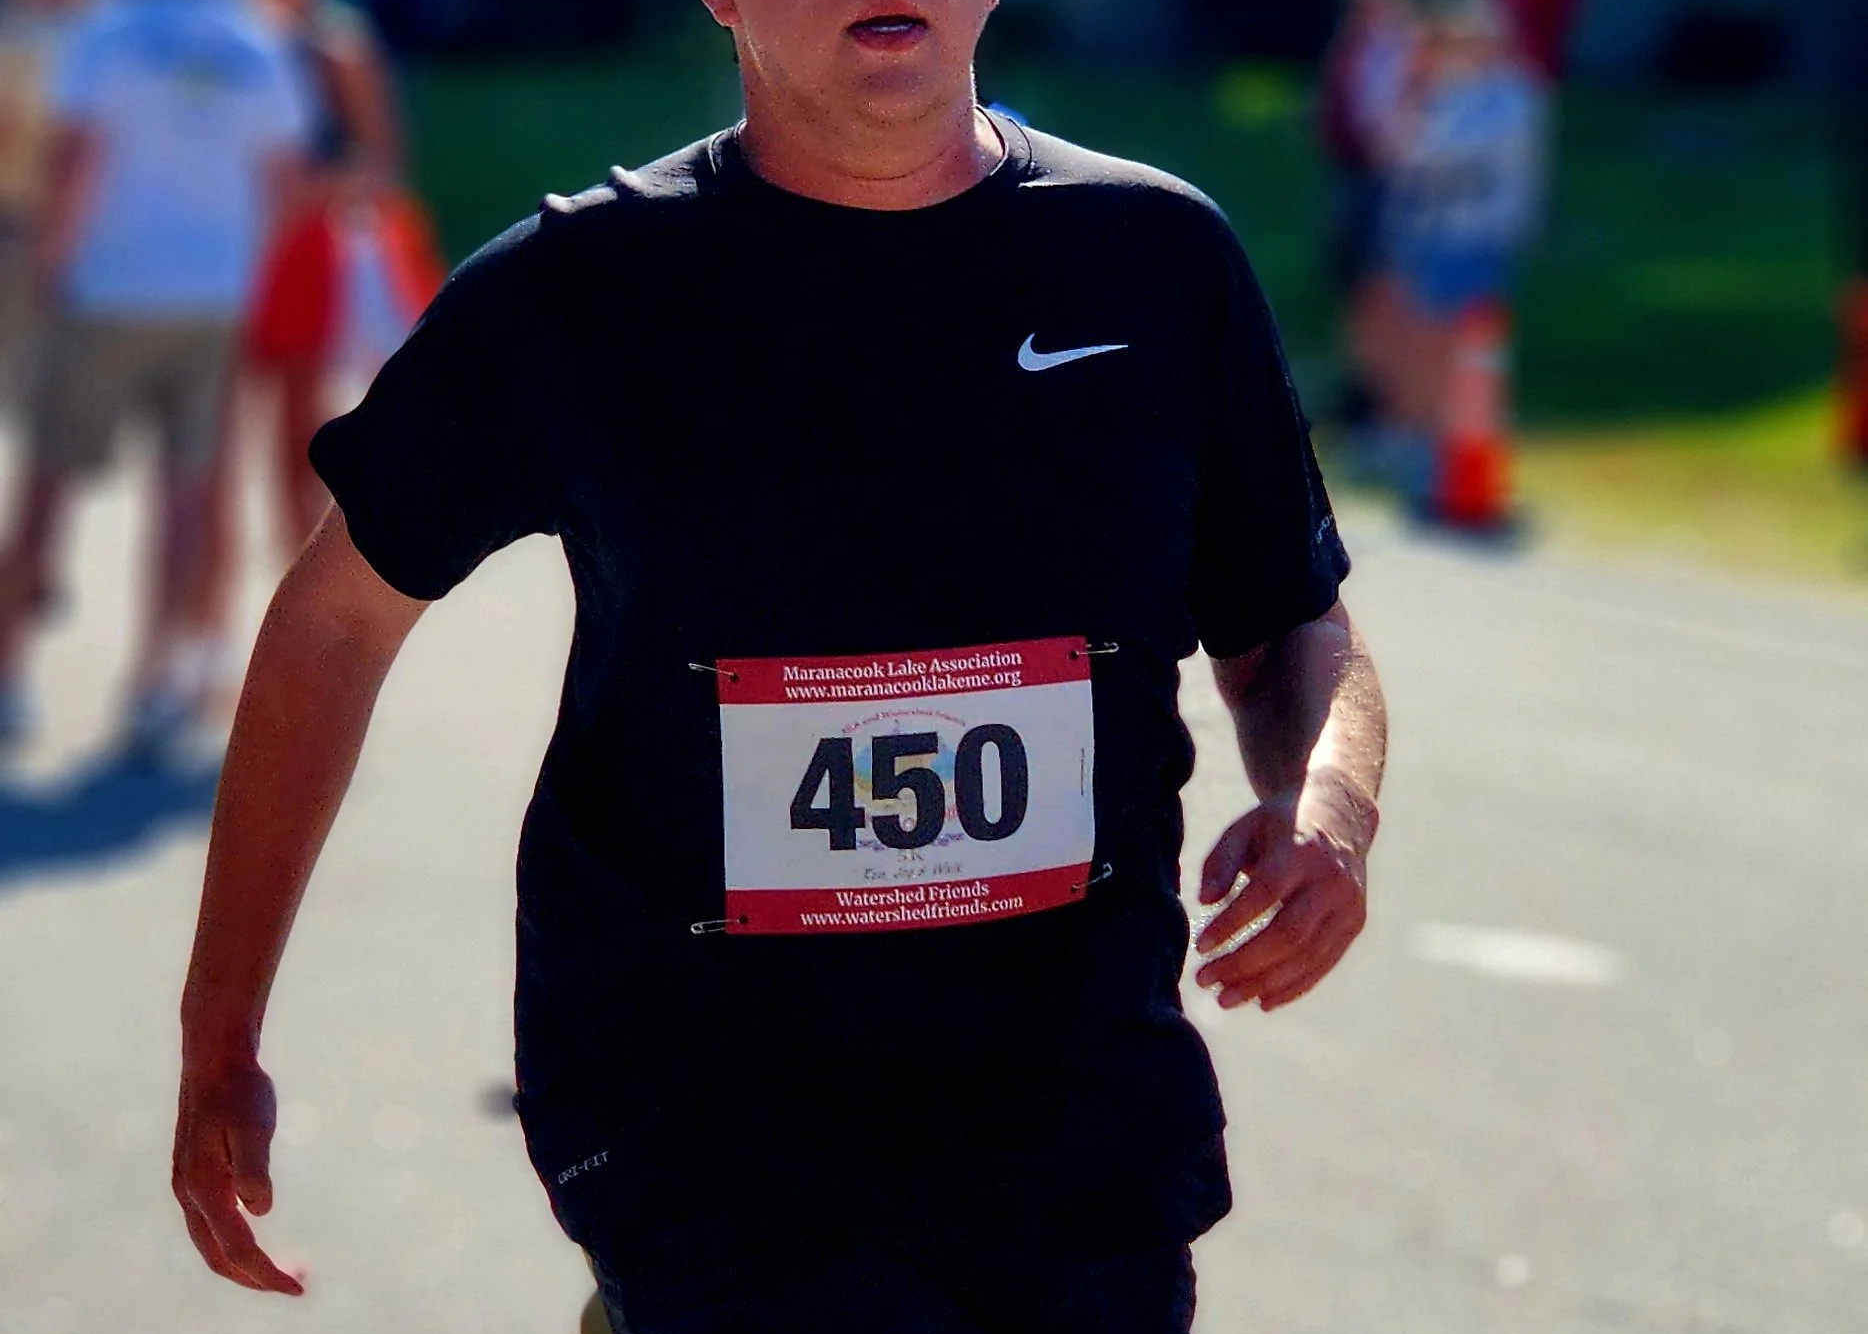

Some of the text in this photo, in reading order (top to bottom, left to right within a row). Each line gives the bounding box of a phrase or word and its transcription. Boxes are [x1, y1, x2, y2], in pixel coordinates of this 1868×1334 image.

[782, 650, 1022, 683] Maranacook Lake Association
[784, 670, 1022, 699] www.maranacooklakeme.org
[789, 723, 1029, 851] 450
[835, 880, 990, 907] Watershed Friends
[799, 896, 1024, 927] www.watershedfriends.com
